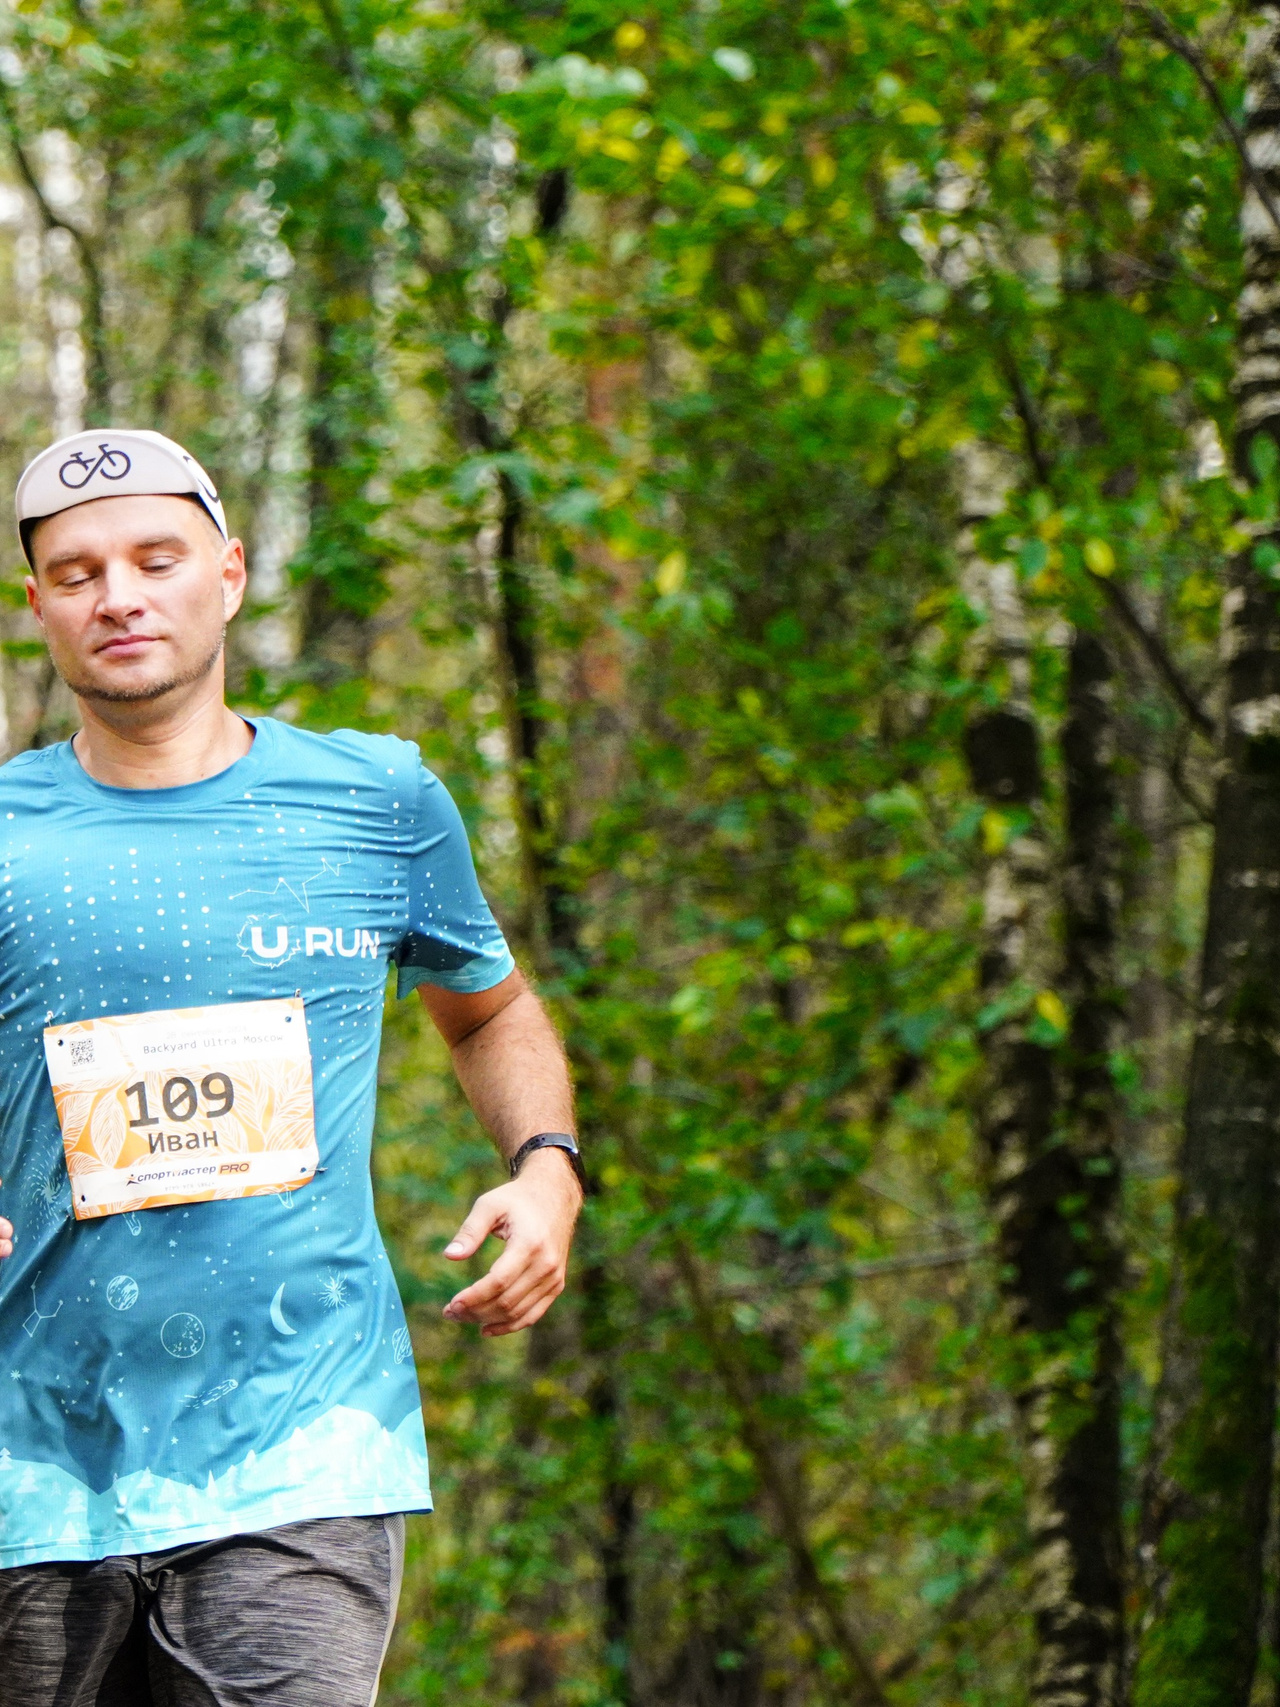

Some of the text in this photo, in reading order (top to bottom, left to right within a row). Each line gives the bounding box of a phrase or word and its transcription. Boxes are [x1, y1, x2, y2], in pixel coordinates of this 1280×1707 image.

[250, 926, 381, 960] U RUN
[143, 1034, 284, 1054] Backyard Ultra Moscow
[124, 1071, 235, 1128] 109
[147, 1130, 219, 1154] Иван
[219, 1162, 251, 1175] PRO
